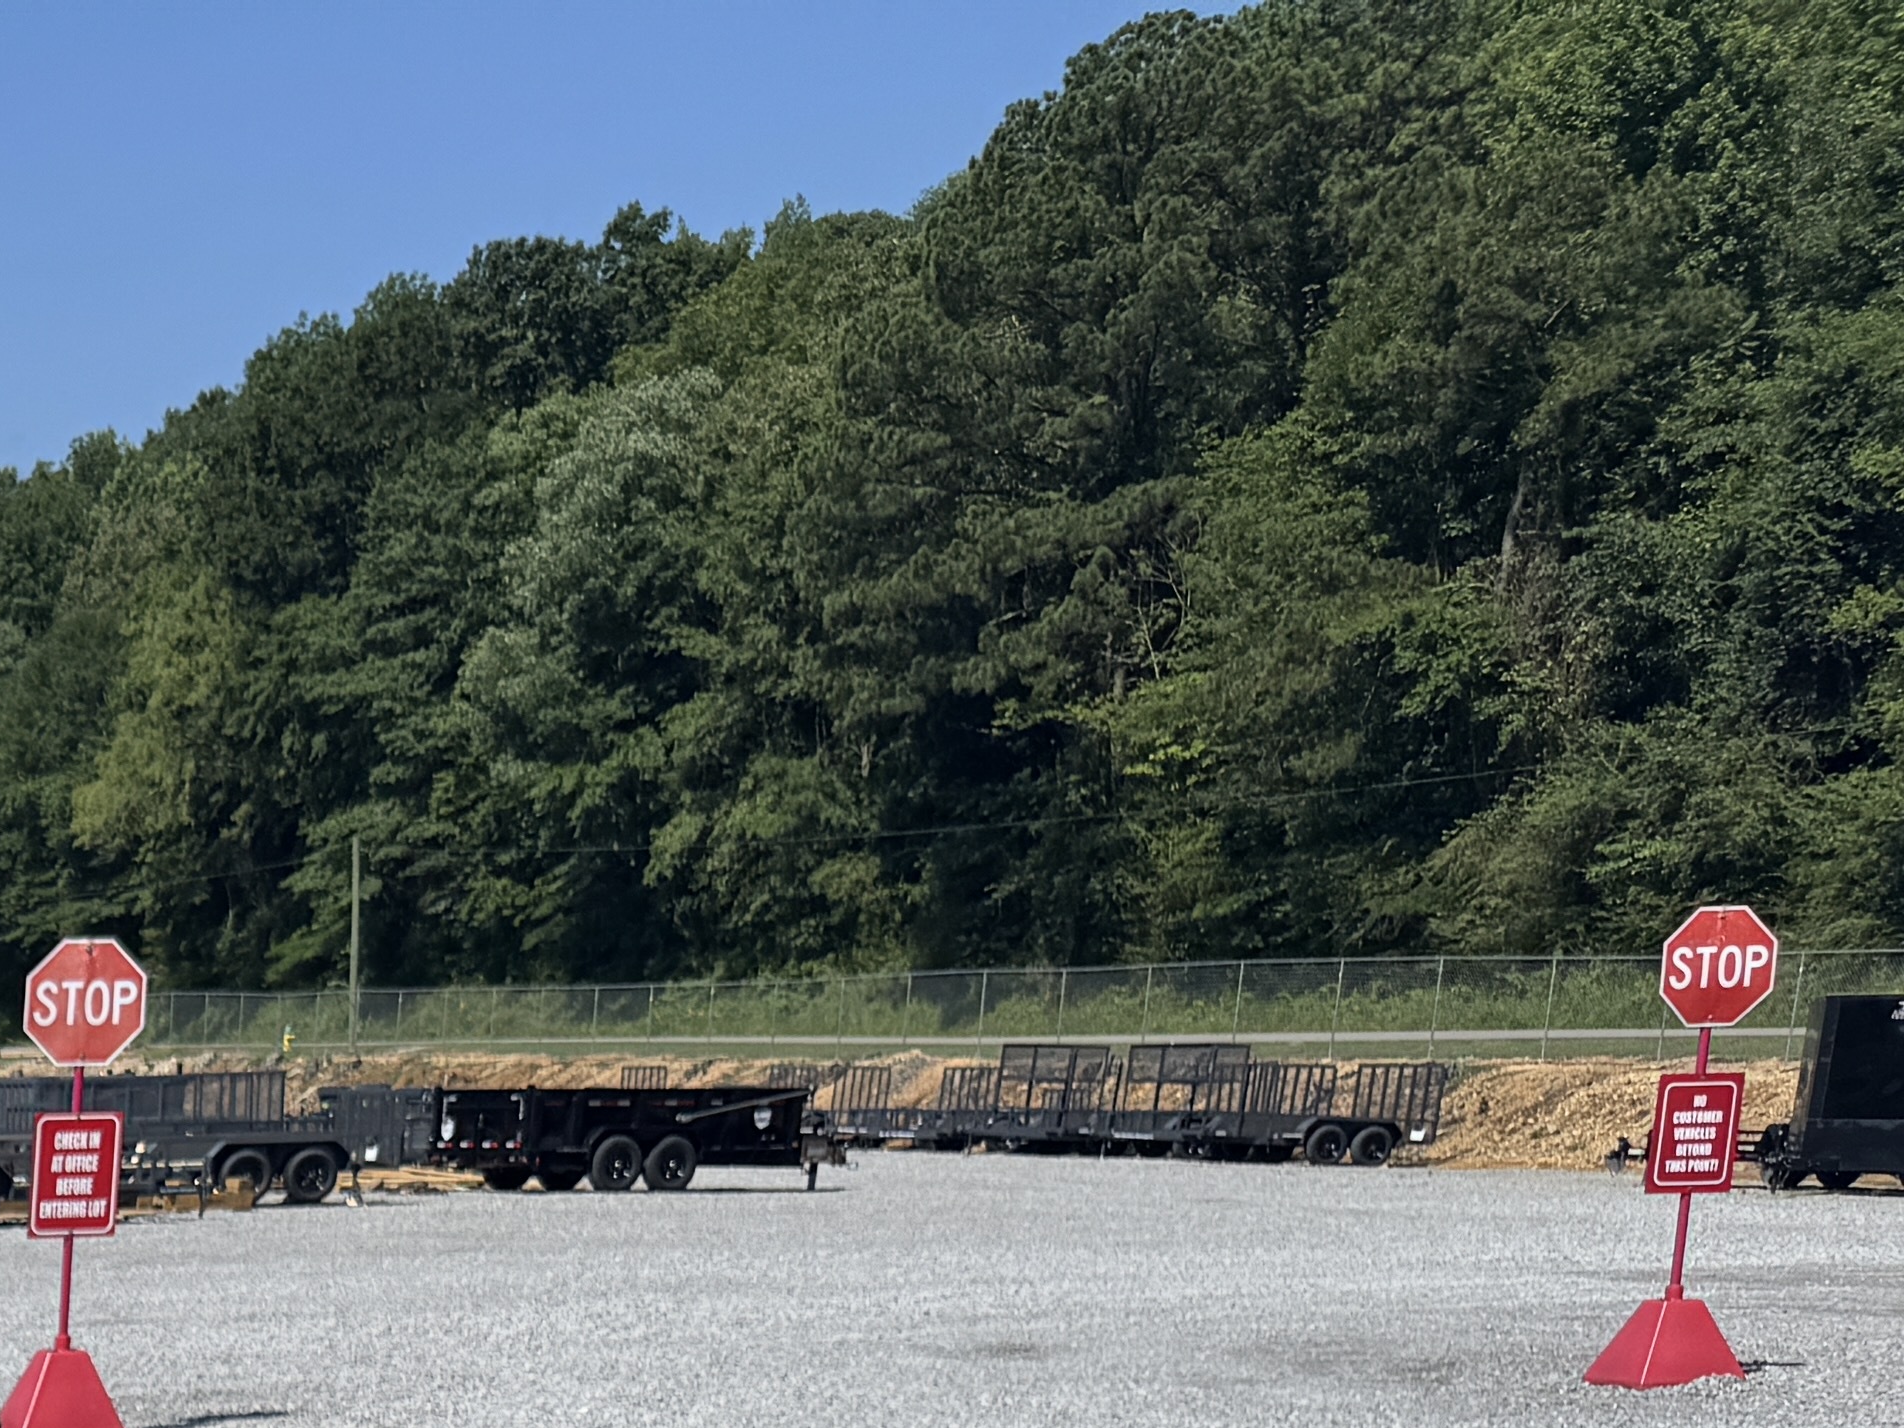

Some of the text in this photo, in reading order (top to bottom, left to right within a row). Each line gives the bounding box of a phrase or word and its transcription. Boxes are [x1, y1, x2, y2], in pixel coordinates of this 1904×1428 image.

[1668, 944, 1770, 991] STOP
[32, 980, 138, 1027] STOP
[1693, 1094, 1708, 1108] NO
[1673, 1110, 1723, 1124] CUSTOMER
[54, 1130, 102, 1150] CHECK IN
[1674, 1127, 1717, 1140] VEHICLES
[1675, 1143, 1713, 1156] BEYOND
[51, 1153, 100, 1173] AT OFFICE
[1665, 1159, 1687, 1173] THIS
[55, 1177, 94, 1196] BEFORE
[39, 1198, 108, 1219] ENTERING LOT
